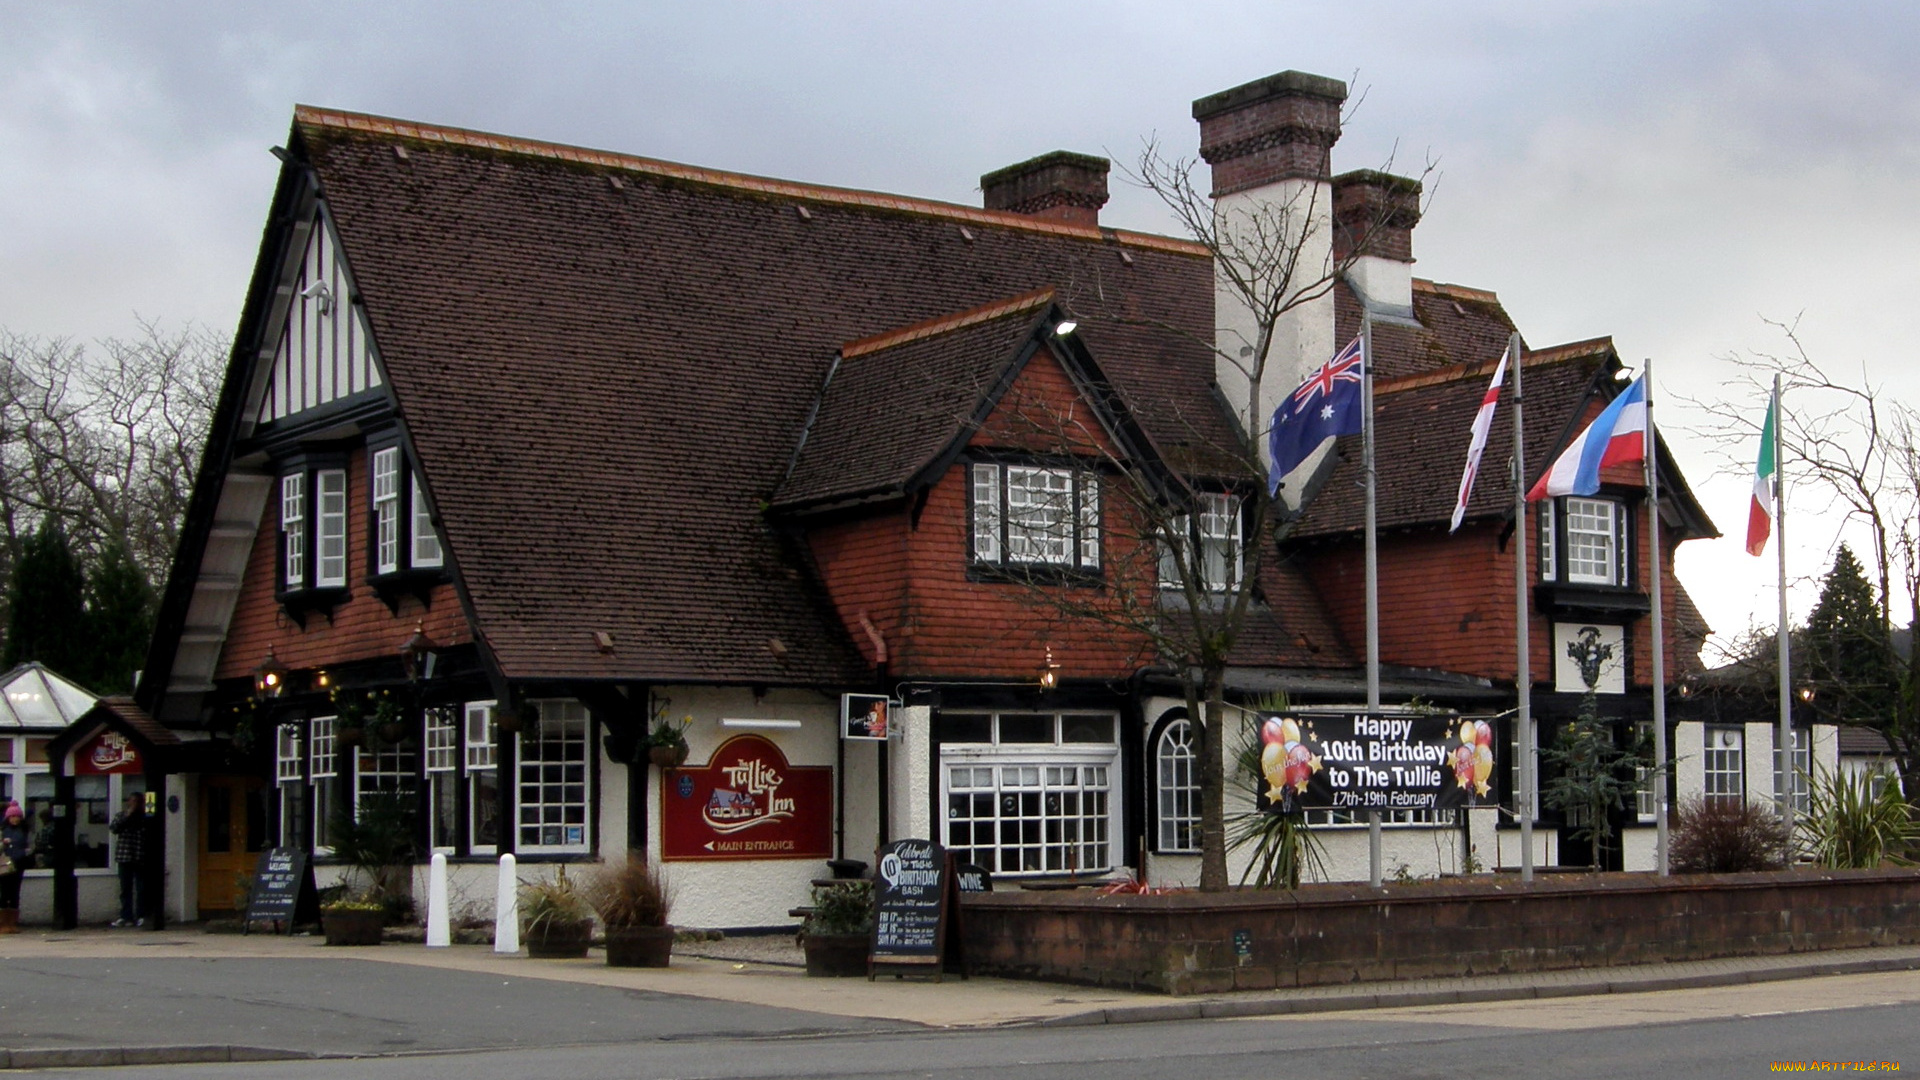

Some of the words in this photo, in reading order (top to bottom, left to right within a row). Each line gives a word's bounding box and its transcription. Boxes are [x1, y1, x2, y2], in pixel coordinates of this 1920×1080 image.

[1354, 715, 1412, 740] Happy
[1321, 741, 1364, 761] 10th
[1369, 741, 1446, 765] Birthday
[722, 759, 783, 795] Tullie
[1329, 767, 1349, 787] to
[1354, 766, 1389, 787] The
[1392, 766, 1441, 787] Tullie
[768, 786, 796, 815] Inn
[1332, 791, 1387, 806] 17th-19th
[1390, 791, 1437, 808] February
[717, 841, 743, 851] MAIN
[745, 840, 794, 851] ENTRANCE
[900, 870, 940, 886] BIRTHDAY
[956, 872, 984, 890] WINE
[902, 886, 923, 896] BASH
